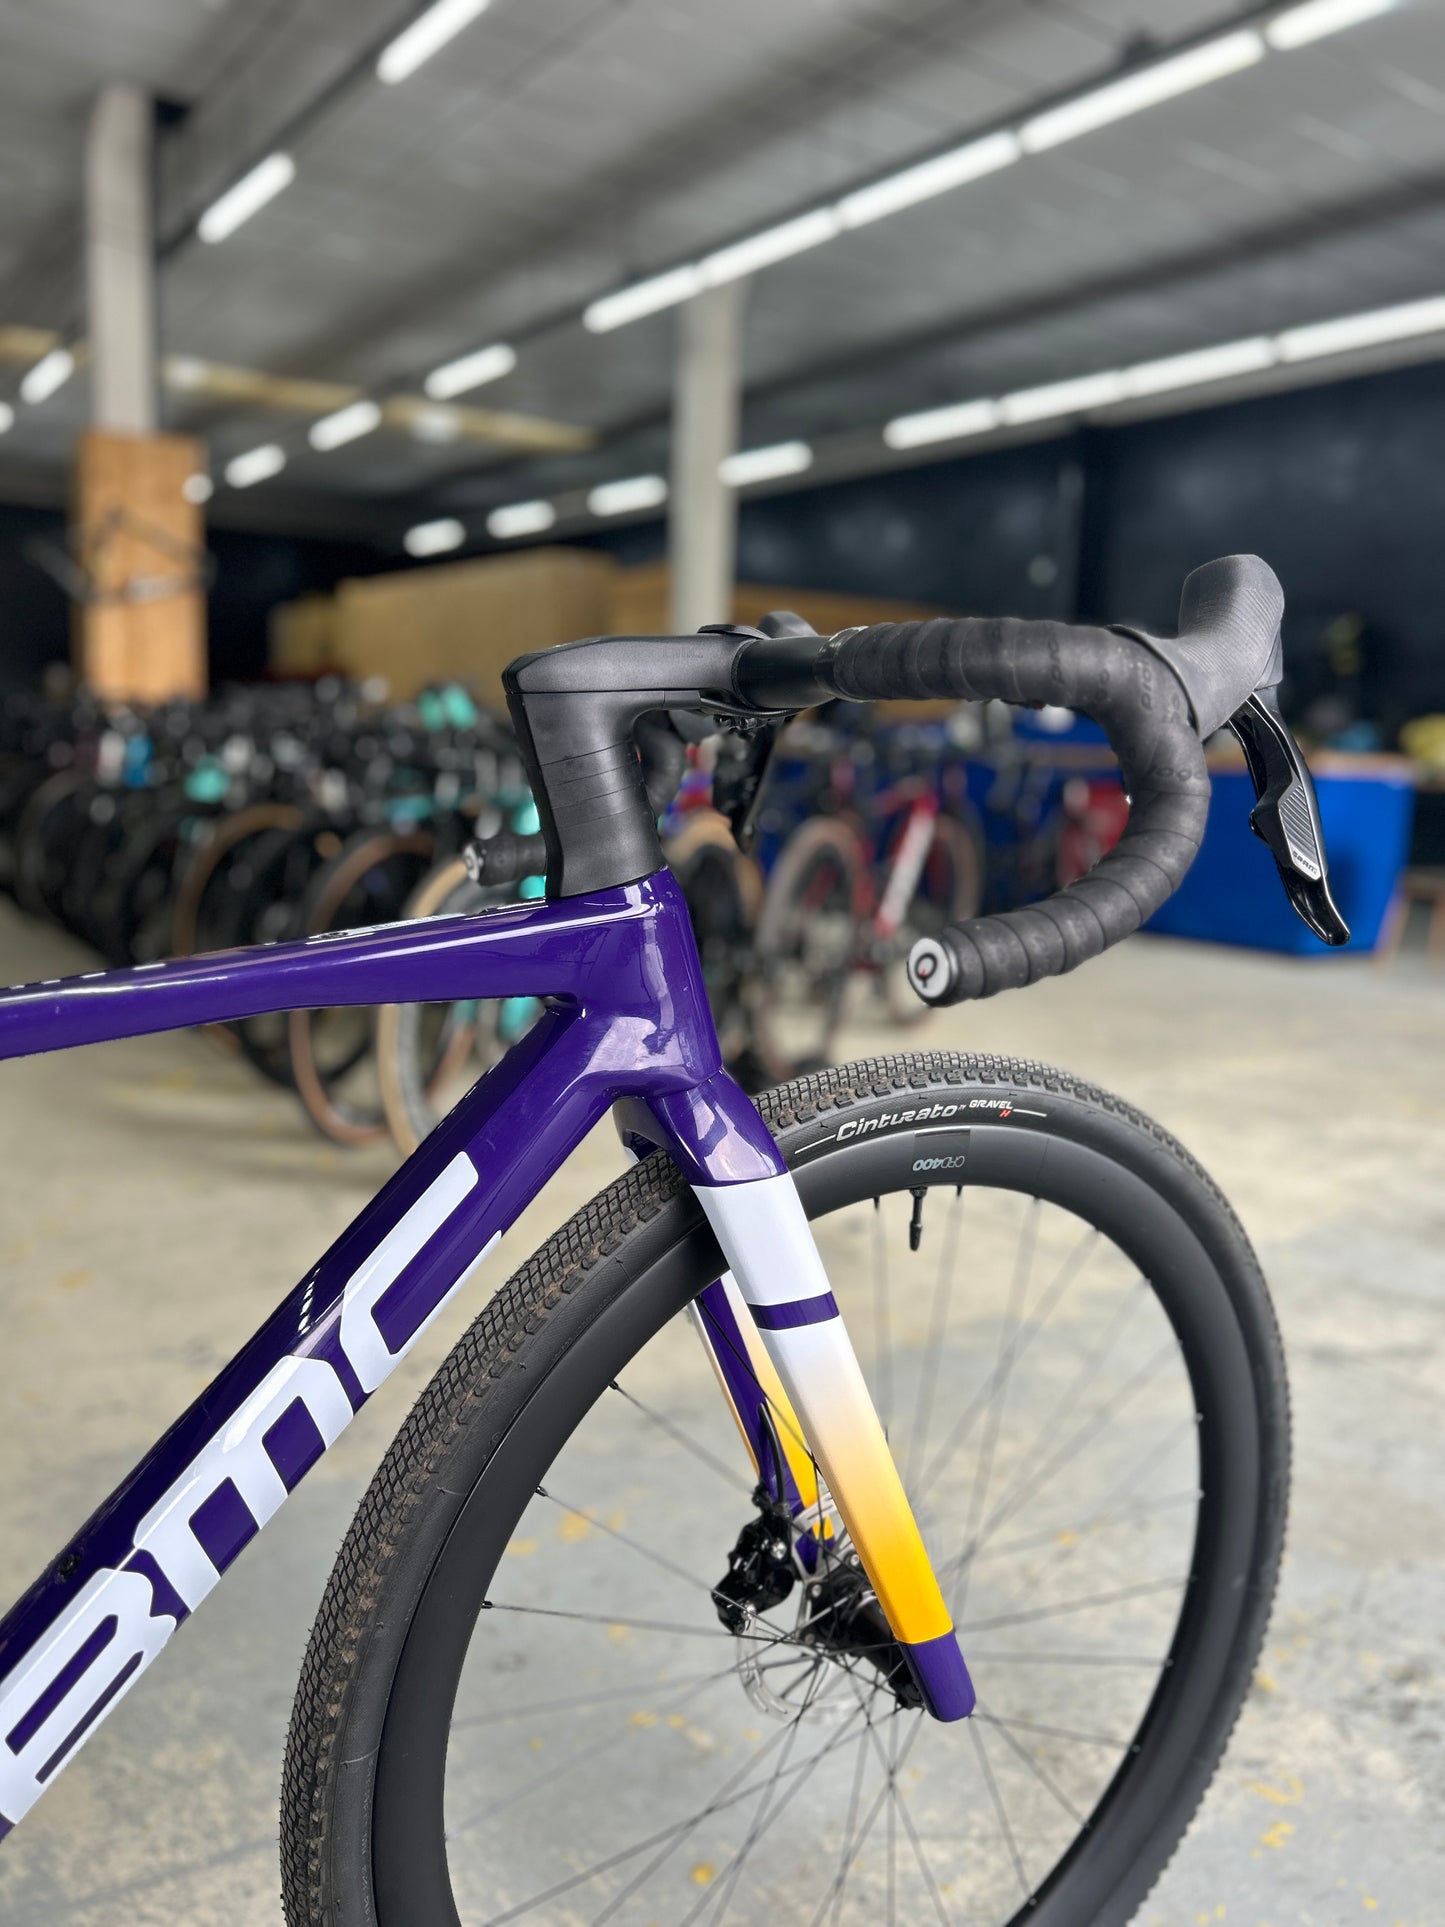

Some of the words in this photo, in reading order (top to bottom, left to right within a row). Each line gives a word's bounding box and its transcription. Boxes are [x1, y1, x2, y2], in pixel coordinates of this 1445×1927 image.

[836, 1104, 957, 1142] Cinturato
[968, 1099, 1013, 1110] GRAVEL
[999, 1109, 1012, 1118] H
